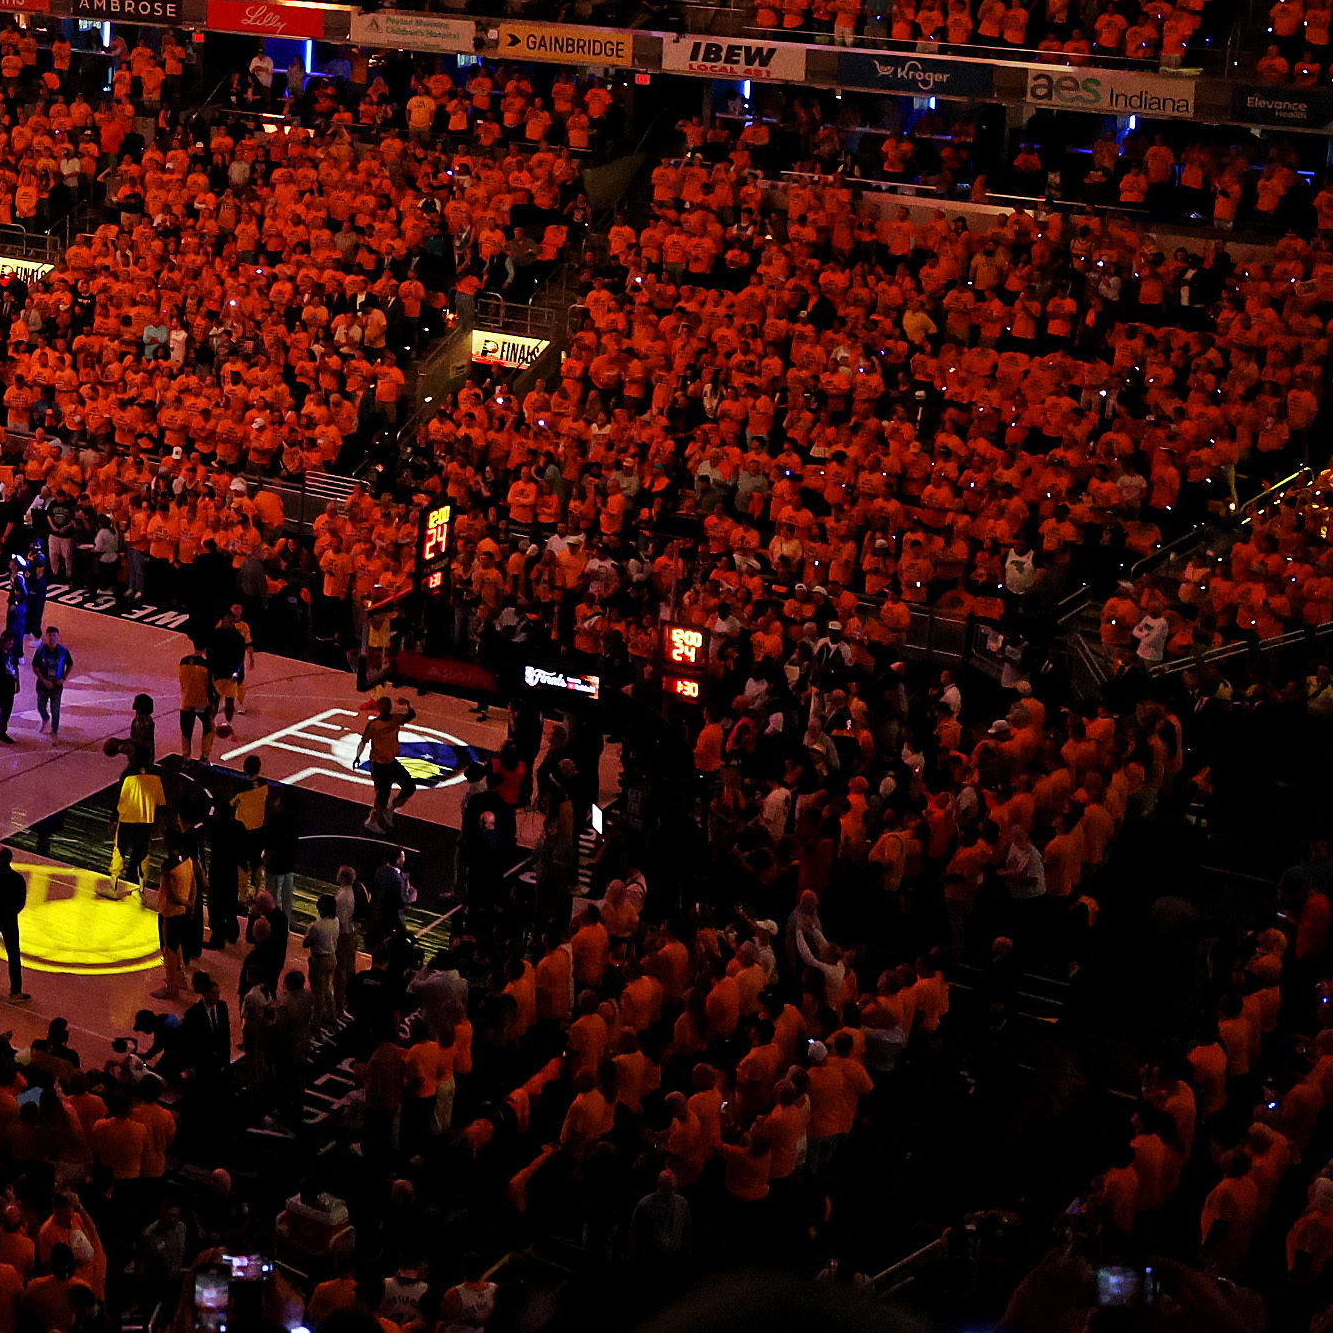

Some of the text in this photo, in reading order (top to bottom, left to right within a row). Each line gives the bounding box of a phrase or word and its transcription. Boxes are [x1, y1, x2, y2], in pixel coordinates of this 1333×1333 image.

[240, 4, 288, 35] Lilly
[525, 33, 626, 59] GAINBRIDGE
[689, 41, 777, 67] IBEW
[688, 63, 738, 75] LOCAL
[896, 61, 951, 90] Kroger
[1031, 73, 1190, 113] aes Indiana
[1246, 96, 1309, 112] Elevance
[424, 523, 447, 561] 24
[671, 642, 696, 663] 24
